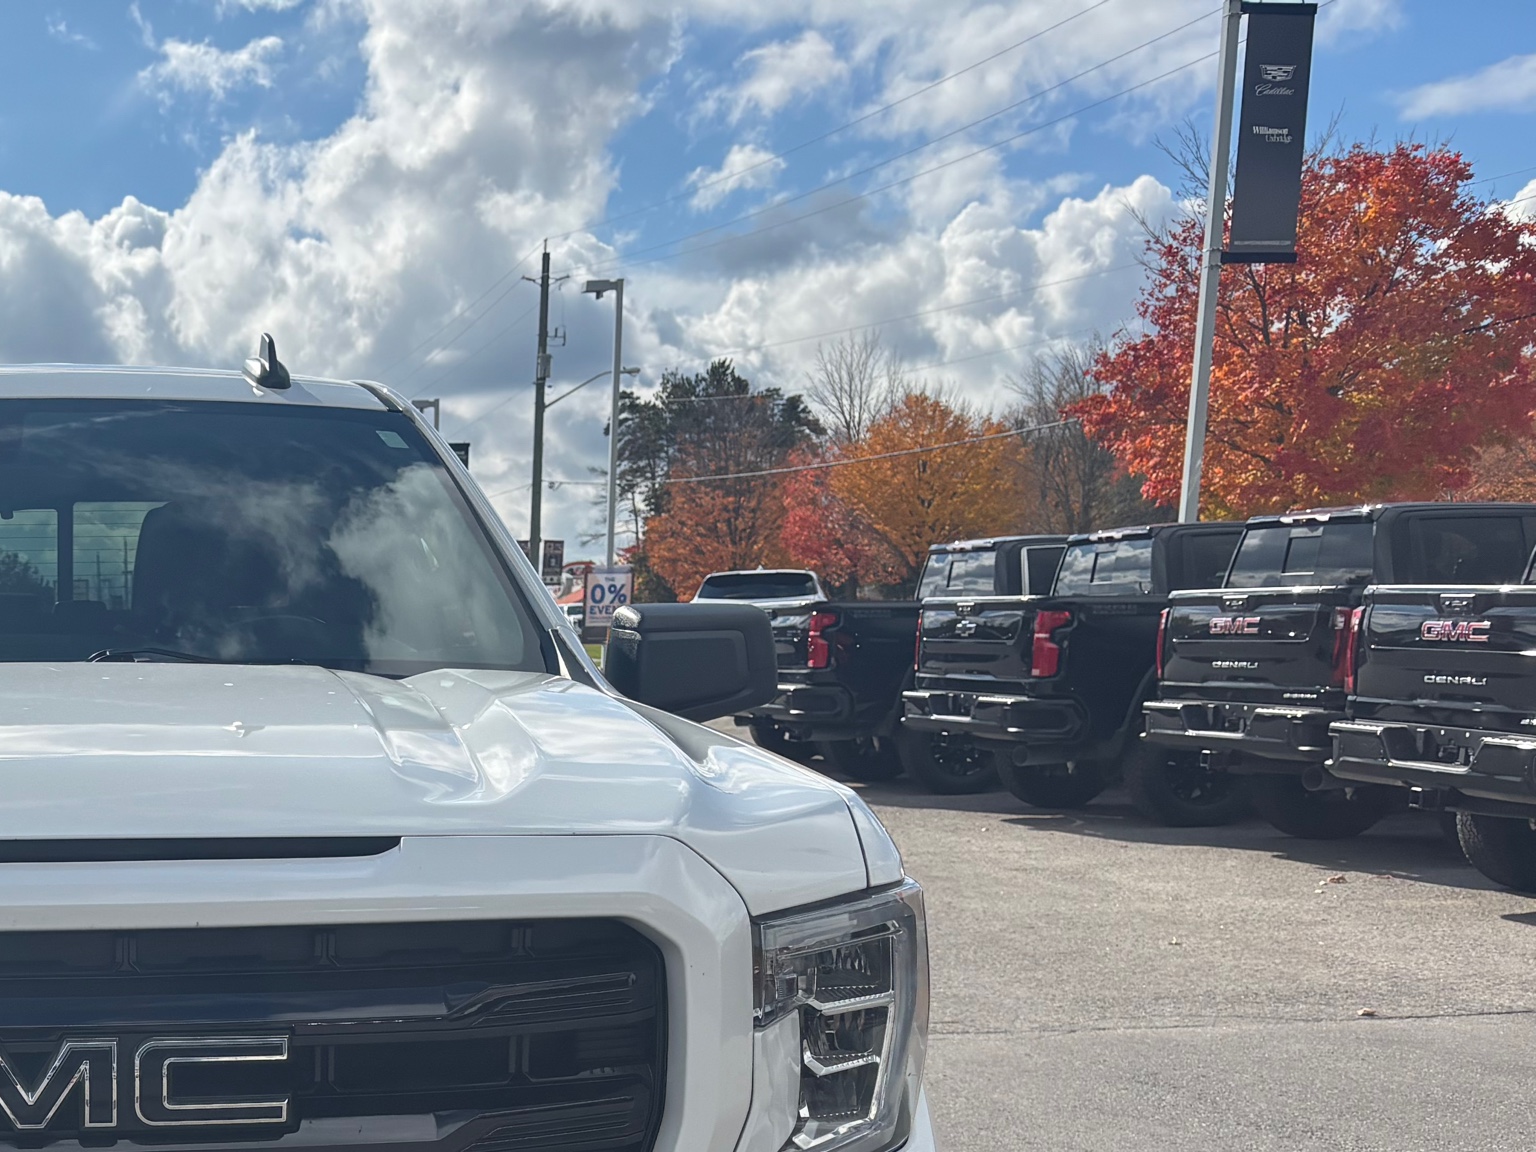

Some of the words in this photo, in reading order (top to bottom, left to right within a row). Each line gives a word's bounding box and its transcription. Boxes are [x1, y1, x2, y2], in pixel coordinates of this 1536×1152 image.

[1254, 83, 1295, 96] Cadillac
[590, 583, 627, 605] 0%
[1209, 616, 1261, 635] GMC
[1421, 620, 1492, 642] GMC
[1212, 661, 1259, 669] DENALI
[1424, 675, 1488, 686] DENALI
